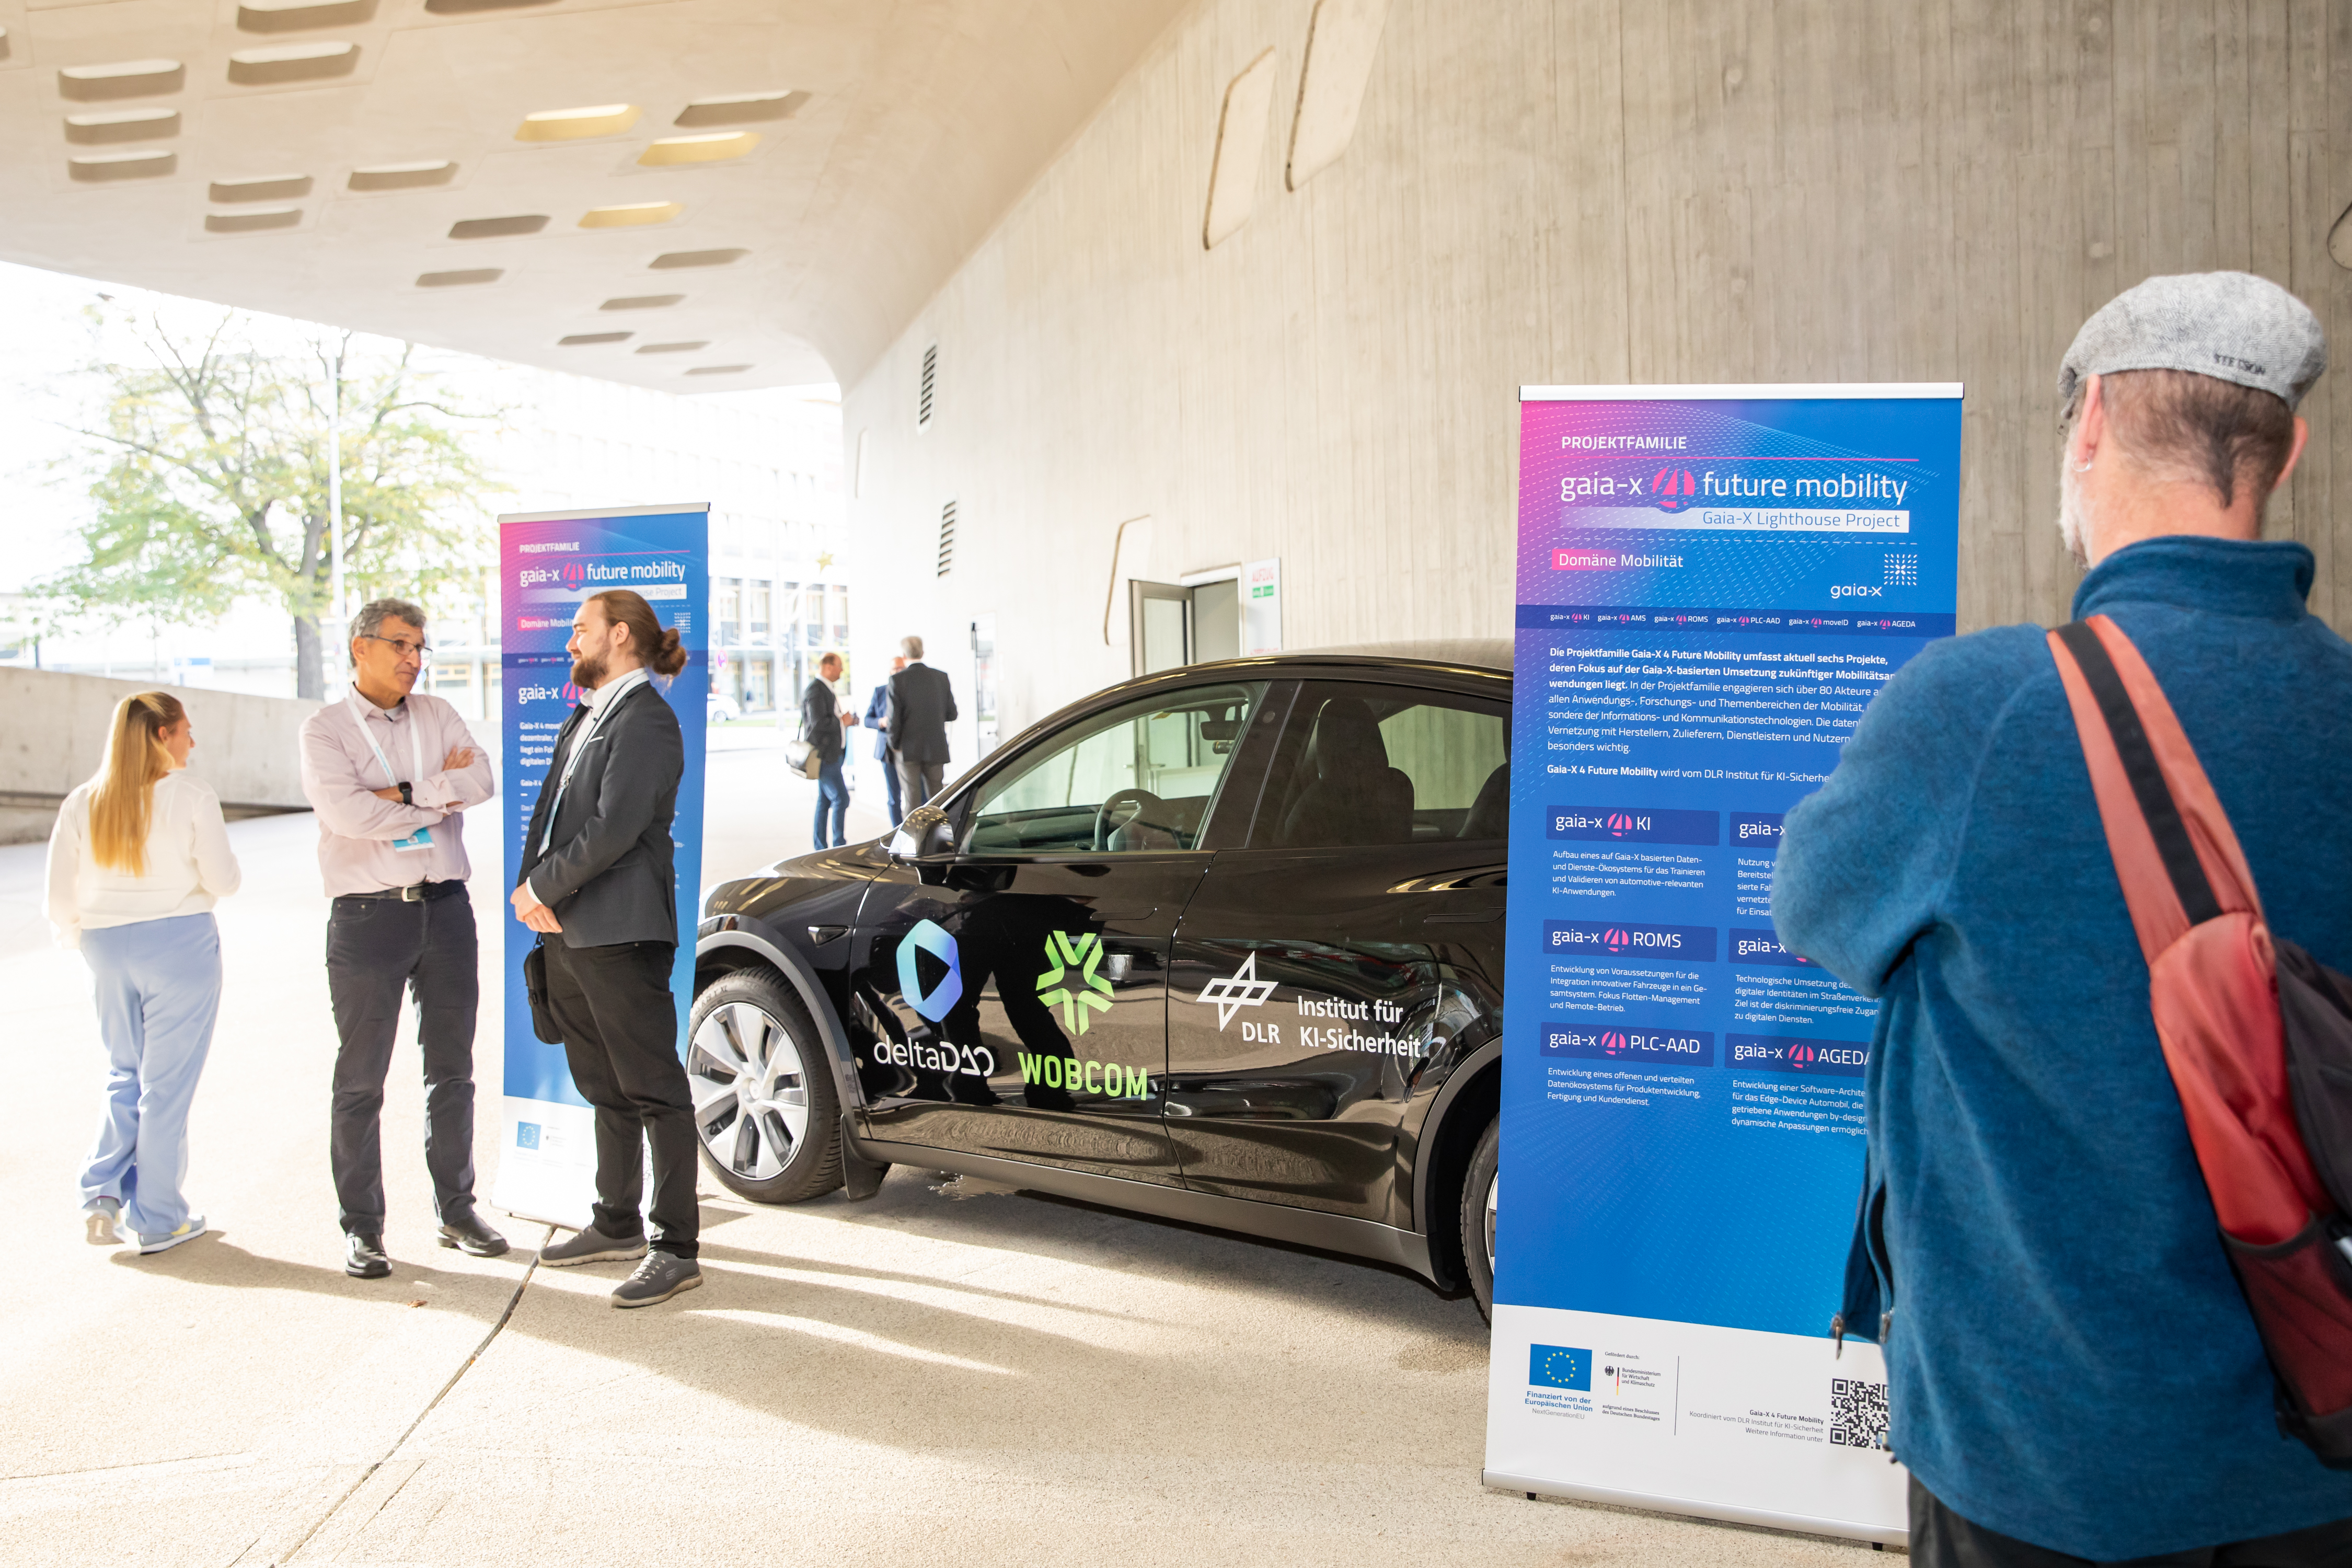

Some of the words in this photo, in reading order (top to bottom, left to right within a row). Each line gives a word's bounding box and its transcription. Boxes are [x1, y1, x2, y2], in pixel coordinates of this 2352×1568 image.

[1560, 435, 1687, 451] PROJEKTFAMILIE
[1560, 472, 1643, 502] gaia-x
[1703, 471, 1786, 497] future
[1796, 472, 1908, 505] mobility
[1703, 511, 1752, 524] Gaia-X
[1757, 512, 1840, 529] Lighthouse
[1847, 513, 1900, 530] Project
[519, 541, 580, 554] PROJEKTFAMILIE
[1559, 554, 1616, 567] Domäne
[1621, 554, 1684, 567] Mobilität
[520, 566, 560, 587] gaia-x
[586, 563, 628, 580] future
[631, 560, 686, 582] mobility
[655, 586, 682, 596] Project
[1830, 583, 1882, 599] gaia-x
[1566, 648, 1630, 659] Projektfamilie
[1631, 649, 1662, 659] Gaia-X
[1663, 650, 1670, 659] 4
[1671, 650, 1702, 660] Future
[1704, 651, 1742, 663] Mobility
[1743, 652, 1782, 661] umfasst
[1783, 652, 1815, 662] aktuell
[1817, 654, 1844, 663] sechs
[1846, 654, 1888, 666] Projekte,
[1549, 663, 1576, 672] deren
[1578, 664, 1606, 673] Fokus
[1607, 664, 1623, 673] auf
[1624, 664, 1641, 674] der
[1642, 665, 1721, 676] Gaia-X-basierten
[1723, 667, 1777, 679] Umsetzung
[1779, 668, 1834, 681] zukünftiger
[518, 683, 559, 705] gaia-x
[1549, 679, 1603, 691] wendungen
[1605, 679, 1628, 691] liegt.
[1630, 681, 1639, 689] In
[1641, 681, 1656, 690] der
[1658, 681, 1721, 693] Projektfamilie
[1722, 683, 1773, 695] engagieren
[1775, 684, 1794, 694] sich
[1796, 685, 1818, 694] über
[1819, 686, 1832, 695] 80
[1834, 686, 1871, 696] Akteure
[1548, 741, 1595, 751] besonders
[1596, 742, 1631, 754] wichtig.
[1547, 764, 1577, 774] Gaia-X
[1579, 766, 1586, 774] 4
[1588, 766, 1618, 775] Future
[1620, 766, 1658, 779] Mobility
[1660, 768, 1680, 777] wird
[1704, 769, 1723, 779] DLR
[1726, 770, 1759, 780] Institut
[1761, 771, 1774, 780] für
[1555, 813, 1602, 831] gaia-x
[1637, 816, 1651, 831] KI
[1739, 821, 1786, 838] gaia-x
[1553, 850, 1579, 859] Aufbau
[1615, 852, 1639, 861] Gaia-X
[1641, 854, 1675, 862] basierten
[1676, 855, 1702, 863] Daten-
[1738, 858, 1770, 869] Nutzung
[1552, 928, 1599, 946] gaia-x
[1633, 932, 1681, 948] ROMS
[1738, 938, 1785, 955] gaia-x
[1550, 990, 1596, 999] samtsystem.
[1598, 991, 1620, 999] Fokus
[1622, 993, 1700, 1005] Flotten-Management
[1298, 995, 1368, 1021] Institut
[1373, 999, 1403, 1023] für
[1565, 1001, 1625, 1012] Remote-Betrieb.
[1745, 1012, 1777, 1022] digitalen
[1779, 1014, 1814, 1023] Diensten.
[1242, 1021, 1281, 1044] DLR
[1300, 1027, 1421, 1059] KI-Sicherheit
[1549, 1031, 1596, 1048] gaia-x
[1631, 1035, 1700, 1053] PLC-AAD
[1734, 1043, 1783, 1060] gaia-x
[1018, 1052, 1147, 1101] WOBCOM
[1547, 1092, 1582, 1103] Fertigung
[1598, 1095, 1650, 1105] Kundendienst.
[1731, 1117, 1777, 1128] dynamische
[1778, 1121, 1829, 1133] Anpassungen
[1527, 1391, 1562, 1401] Finanziert
[1525, 1398, 1571, 1409] Europäischen
[1573, 1403, 1593, 1412] Union
[1532, 1408, 1585, 1420] NextGenerationEU
[1749, 1409, 1770, 1417] Gaia-X
[1798, 1415, 1824, 1425] Mobility
[1745, 1427, 1769, 1436] Weitere
[1770, 1430, 1805, 1440] Information
